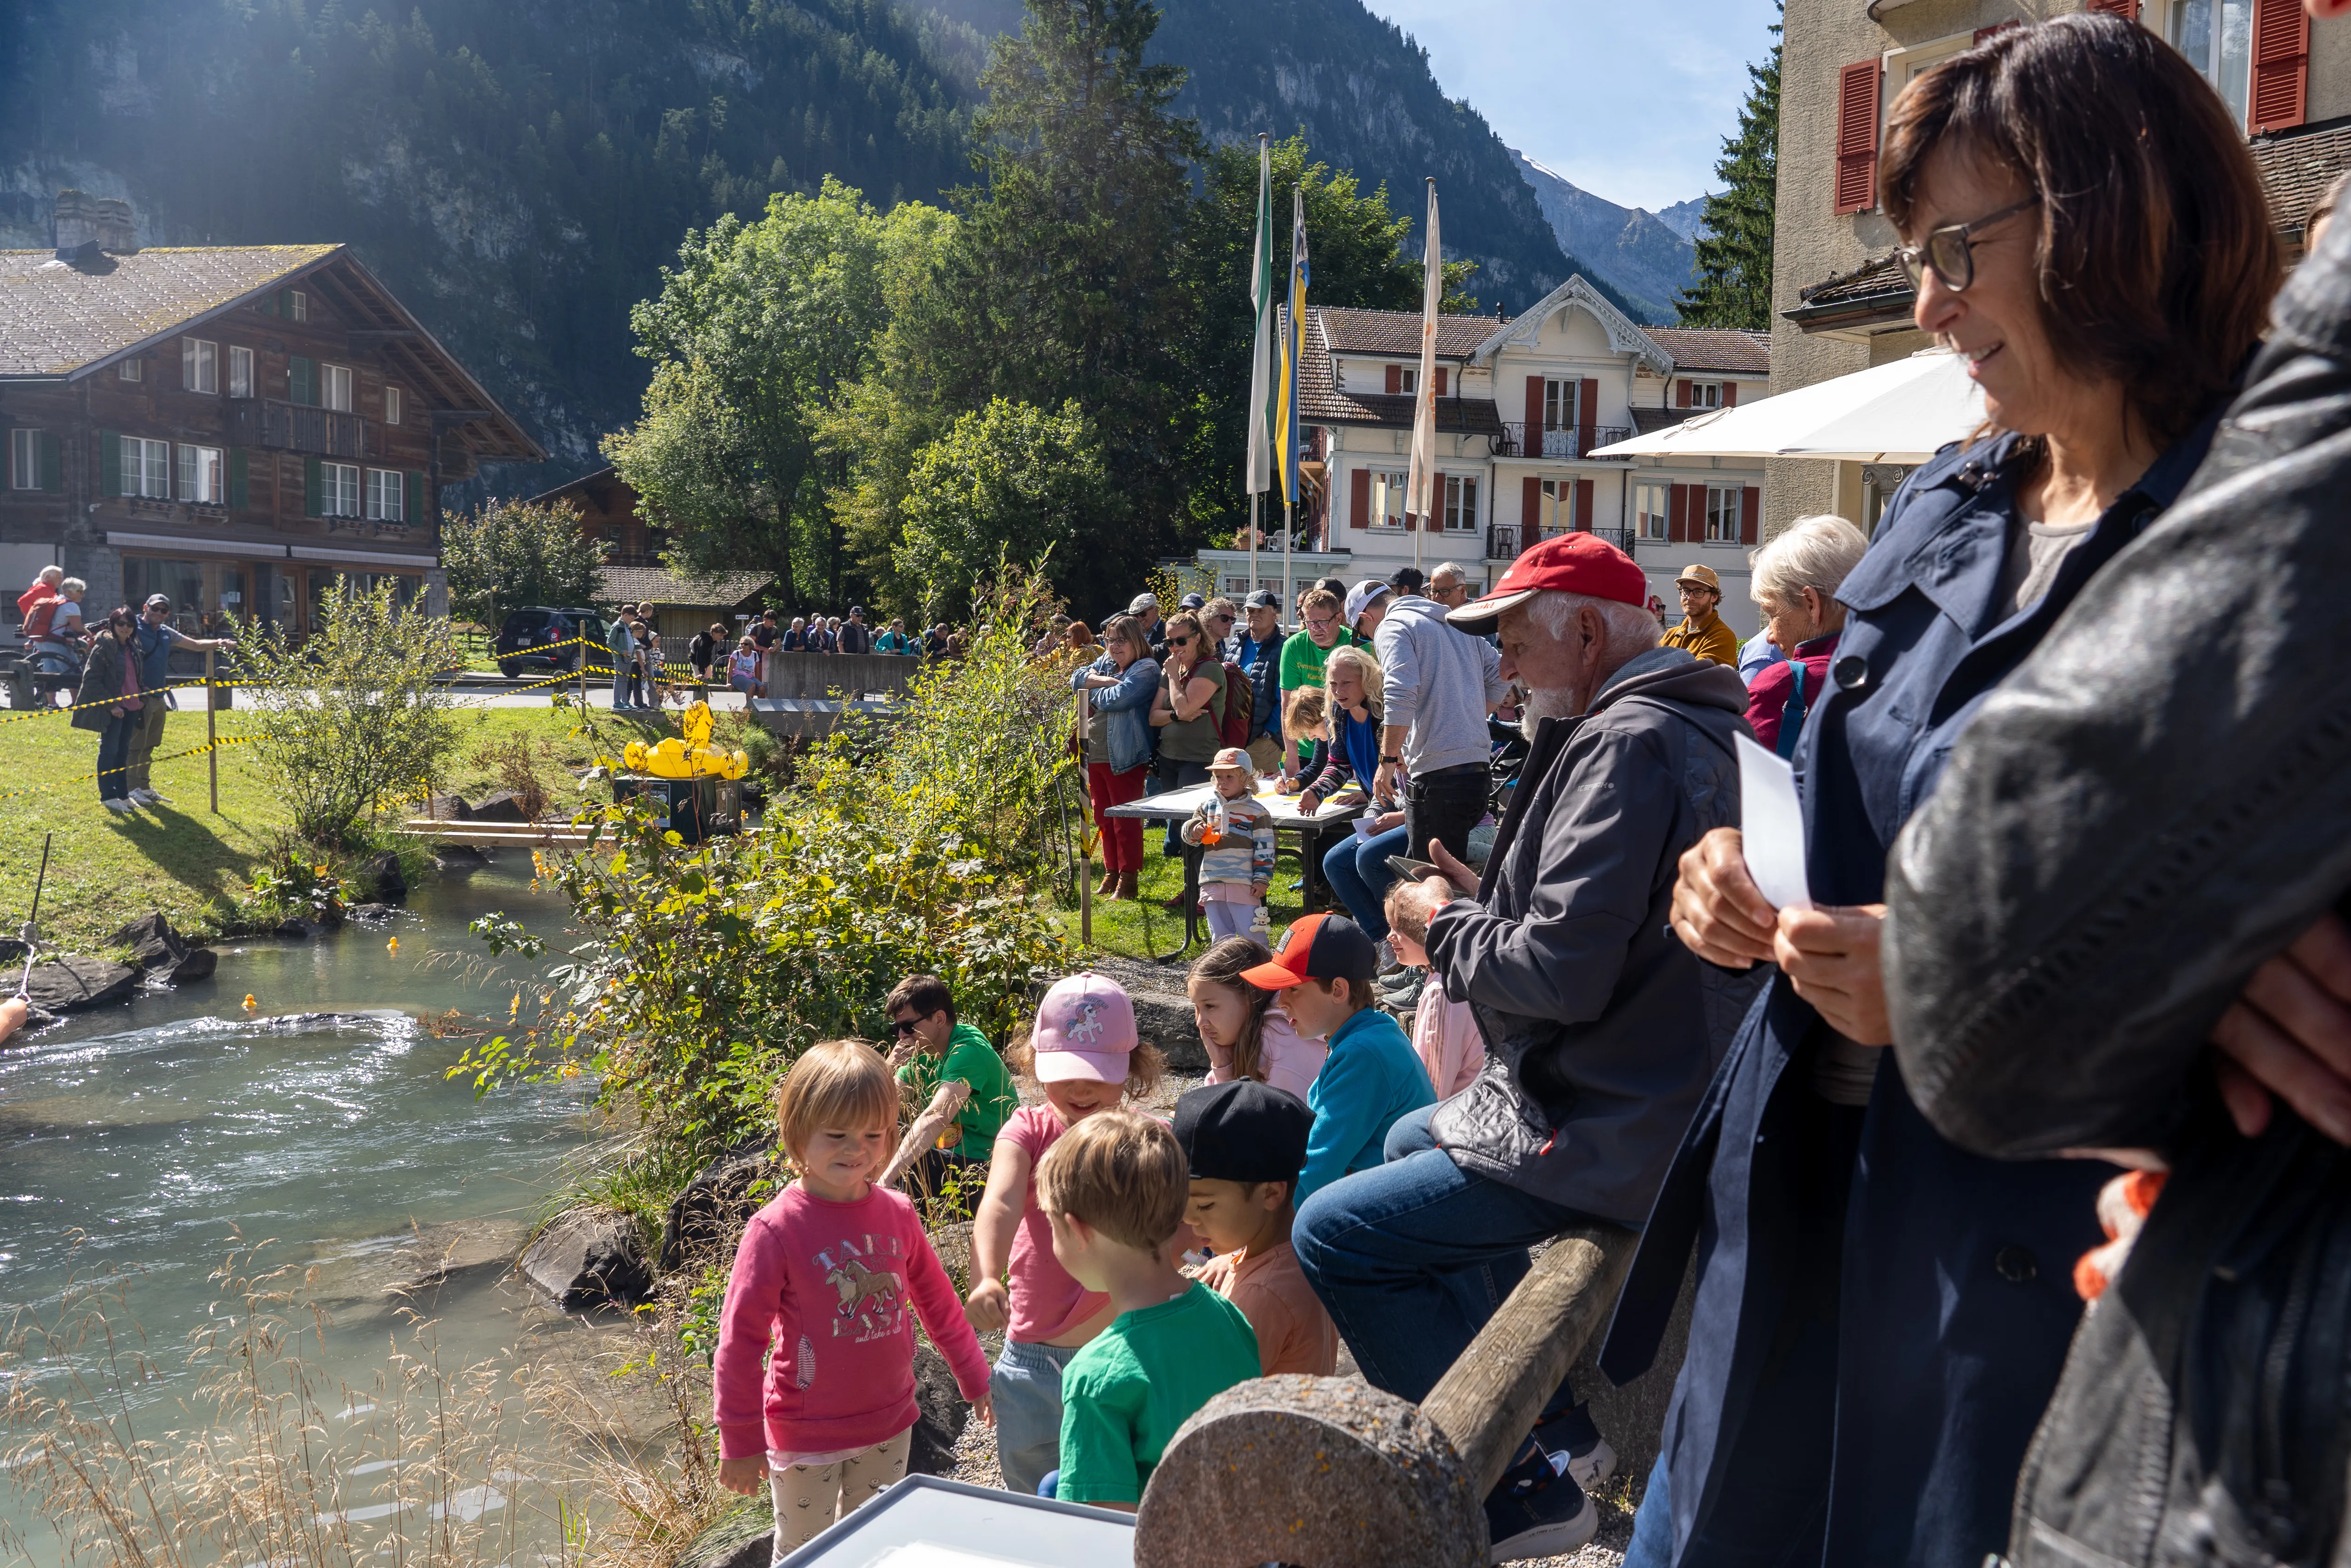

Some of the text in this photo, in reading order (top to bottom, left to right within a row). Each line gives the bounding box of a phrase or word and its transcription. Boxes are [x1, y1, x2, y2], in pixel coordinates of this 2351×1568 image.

[1665, 617, 1677, 626] lpine
[812, 1235, 904, 1274] TAKE
[855, 1330, 870, 1343] and
[871, 1326, 885, 1339] take
